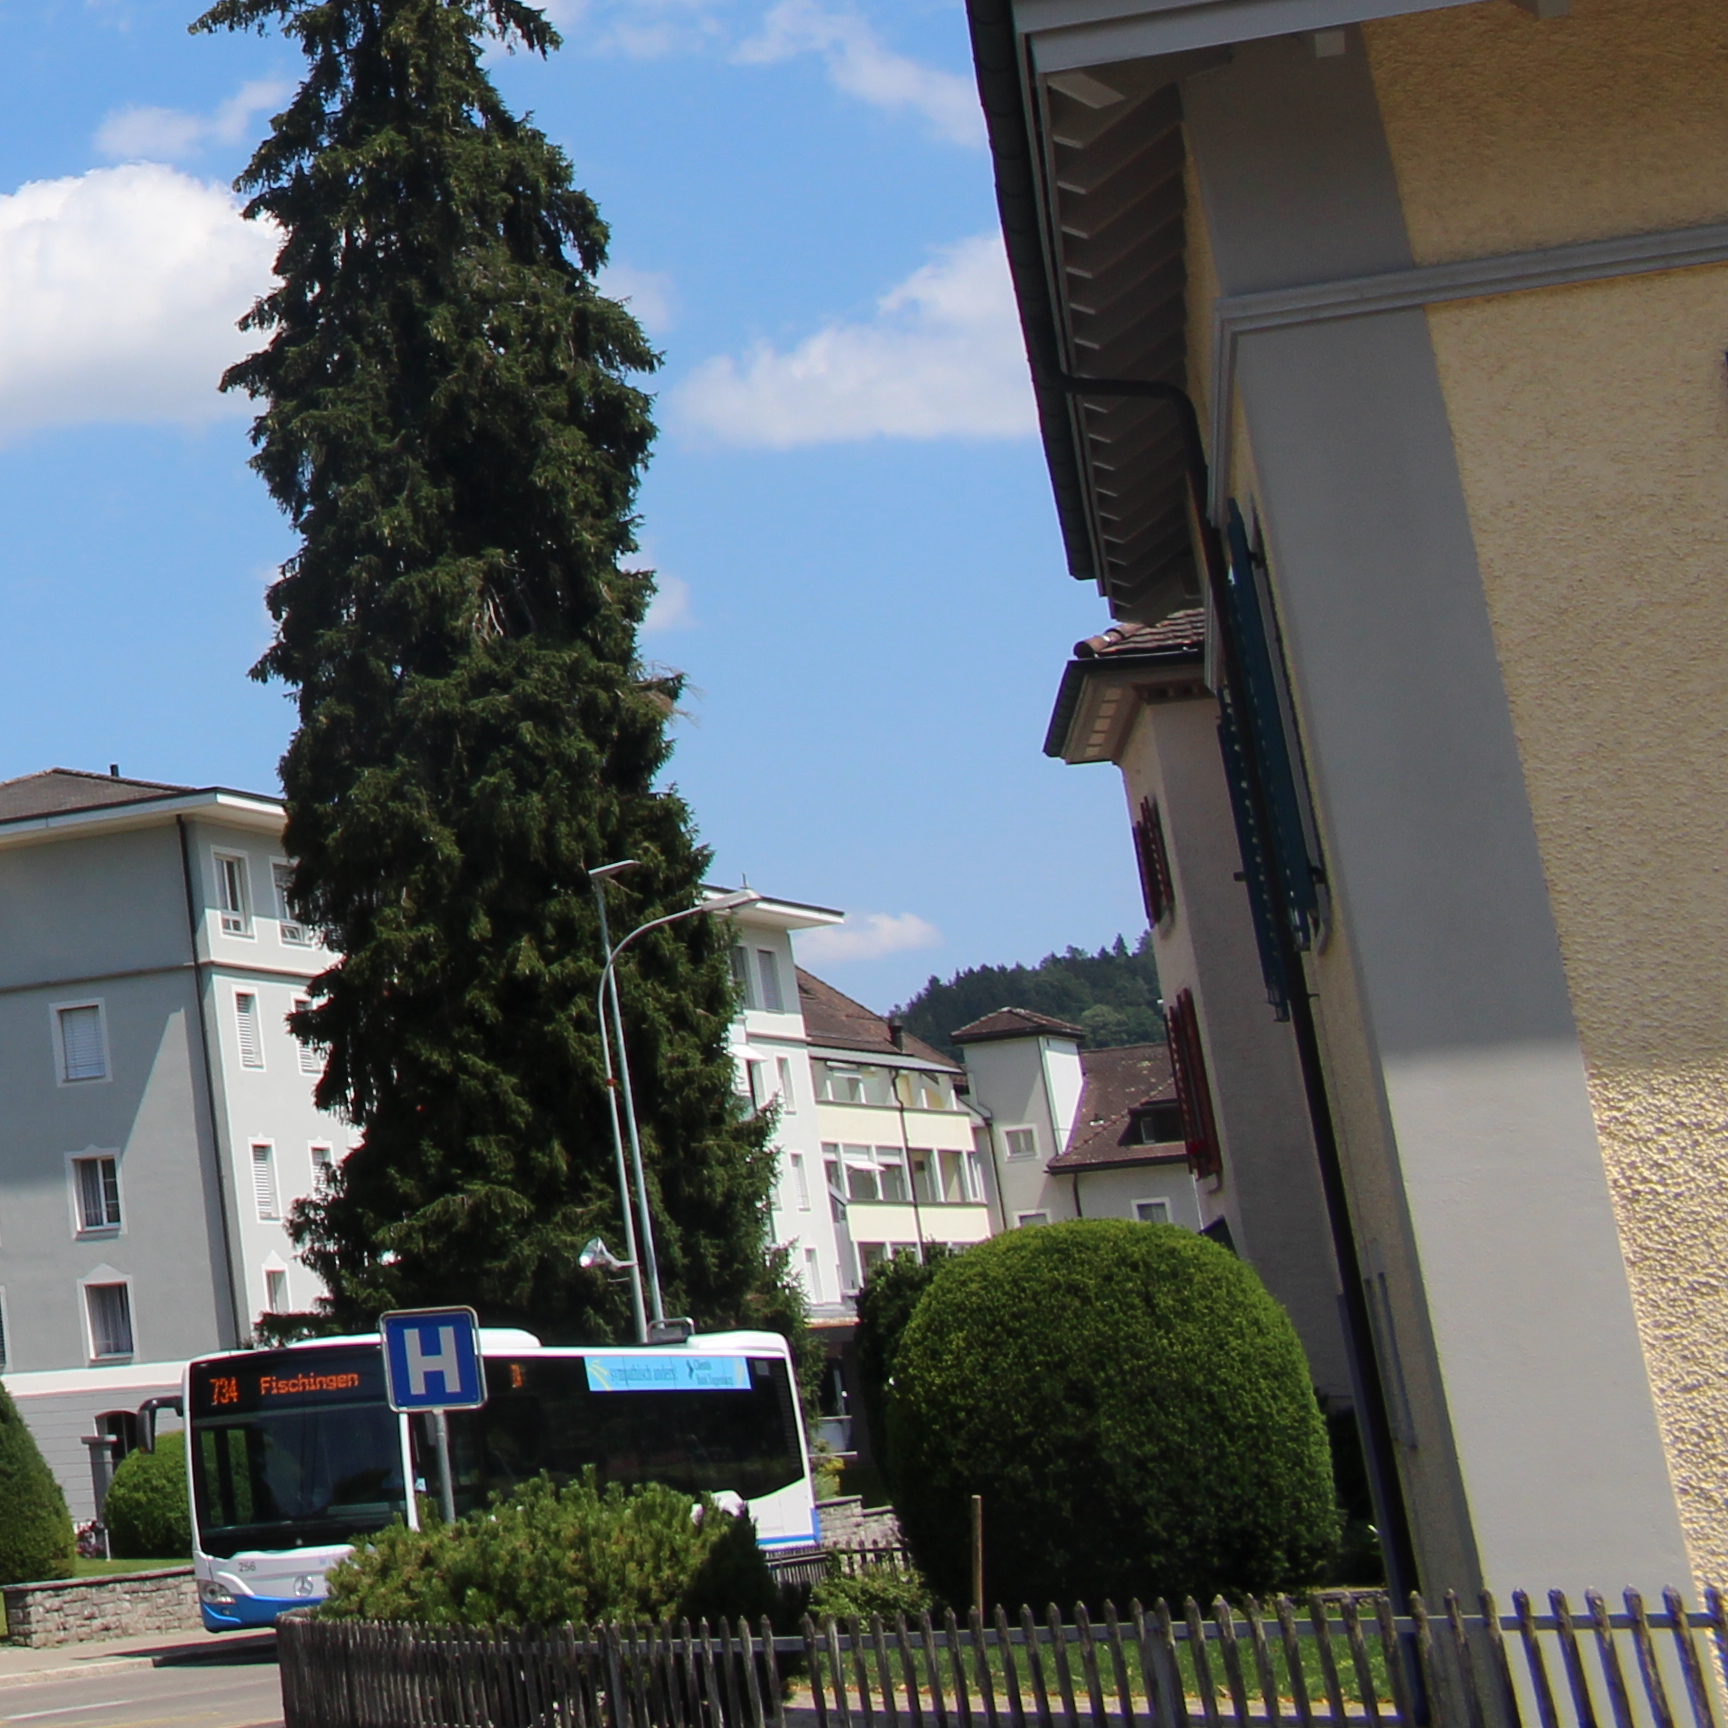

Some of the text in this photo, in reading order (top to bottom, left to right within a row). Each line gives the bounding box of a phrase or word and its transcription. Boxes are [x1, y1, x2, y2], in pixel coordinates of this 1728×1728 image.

[404, 1326, 461, 1395] H
[210, 1372, 359, 1405] 734 Fischingen
